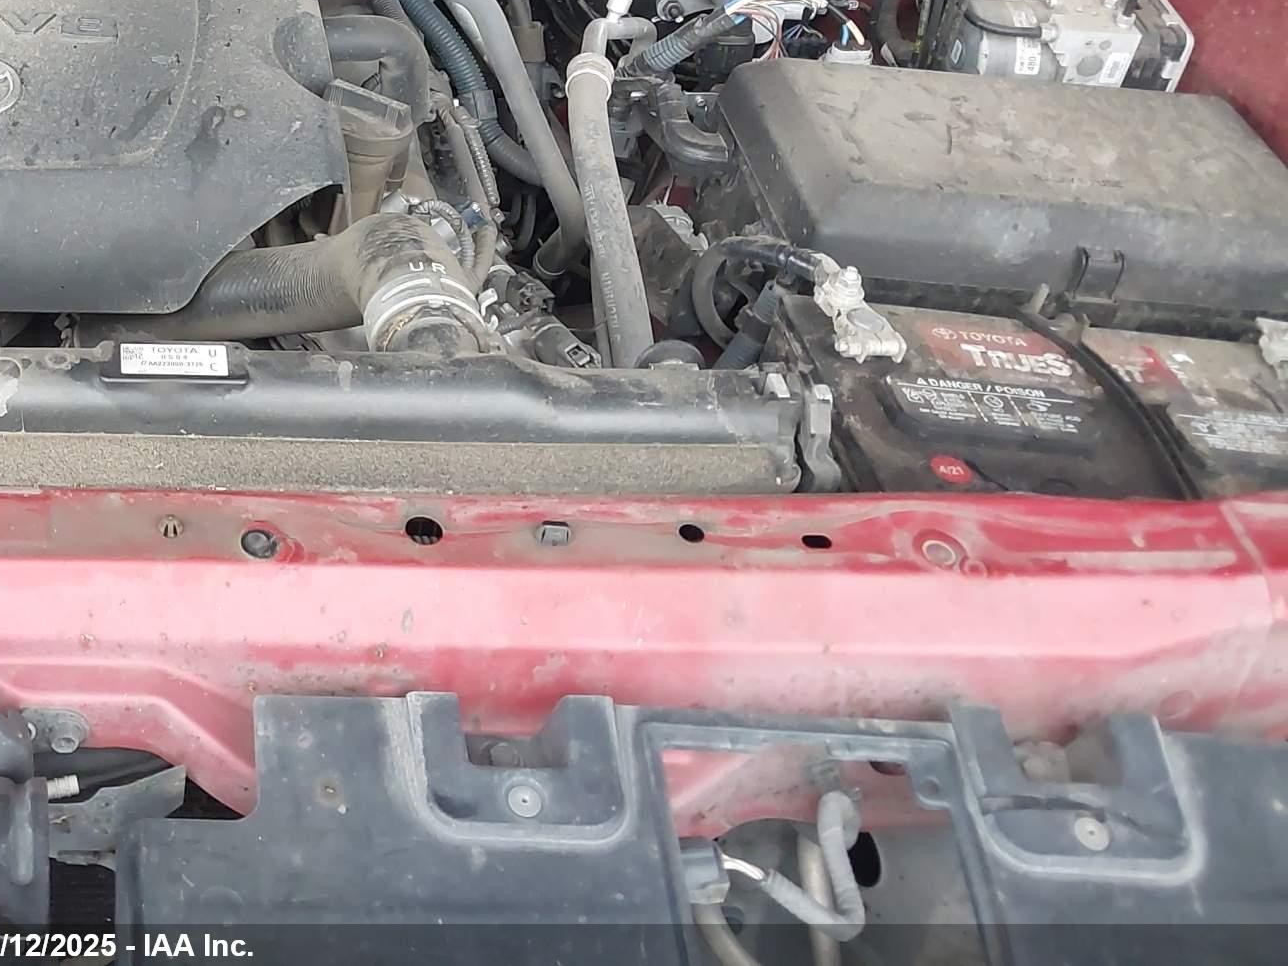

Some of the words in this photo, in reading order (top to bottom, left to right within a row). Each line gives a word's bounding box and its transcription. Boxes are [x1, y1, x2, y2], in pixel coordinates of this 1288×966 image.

[959, 331, 1028, 347] TOYOTA
[927, 378, 983, 393] DANGER
[996, 385, 1046, 398] POISON
